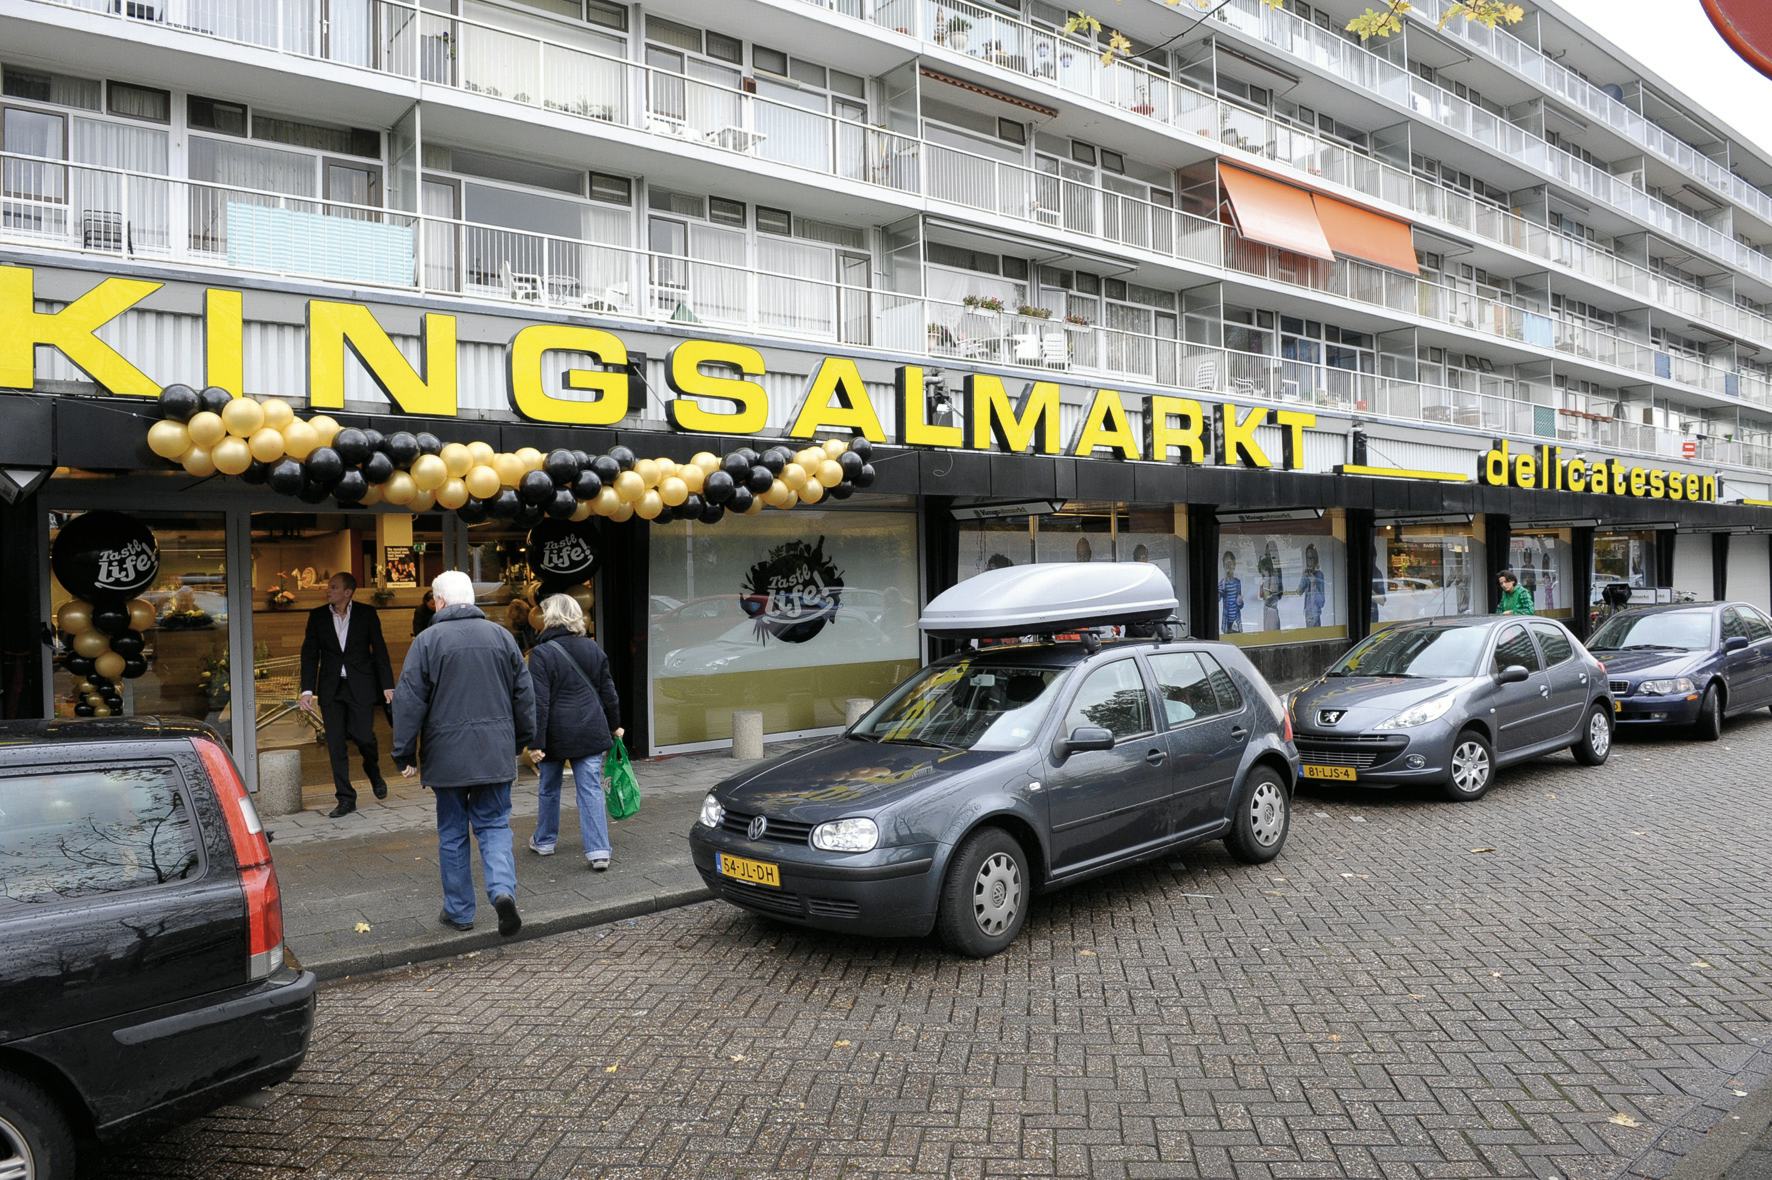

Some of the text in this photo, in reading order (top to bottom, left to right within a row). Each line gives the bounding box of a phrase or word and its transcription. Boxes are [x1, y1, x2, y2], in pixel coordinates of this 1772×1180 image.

[0, 265, 1316, 470] KINGSALMARKT
[1478, 439, 1716, 503] delicatessen
[99, 539, 142, 562] Taste
[544, 533, 578, 550] Taste
[768, 563, 811, 589] Taste
[1308, 766, 1350, 779] 81-LJS-4
[723, 857, 775, 883] 54-JL-DH
